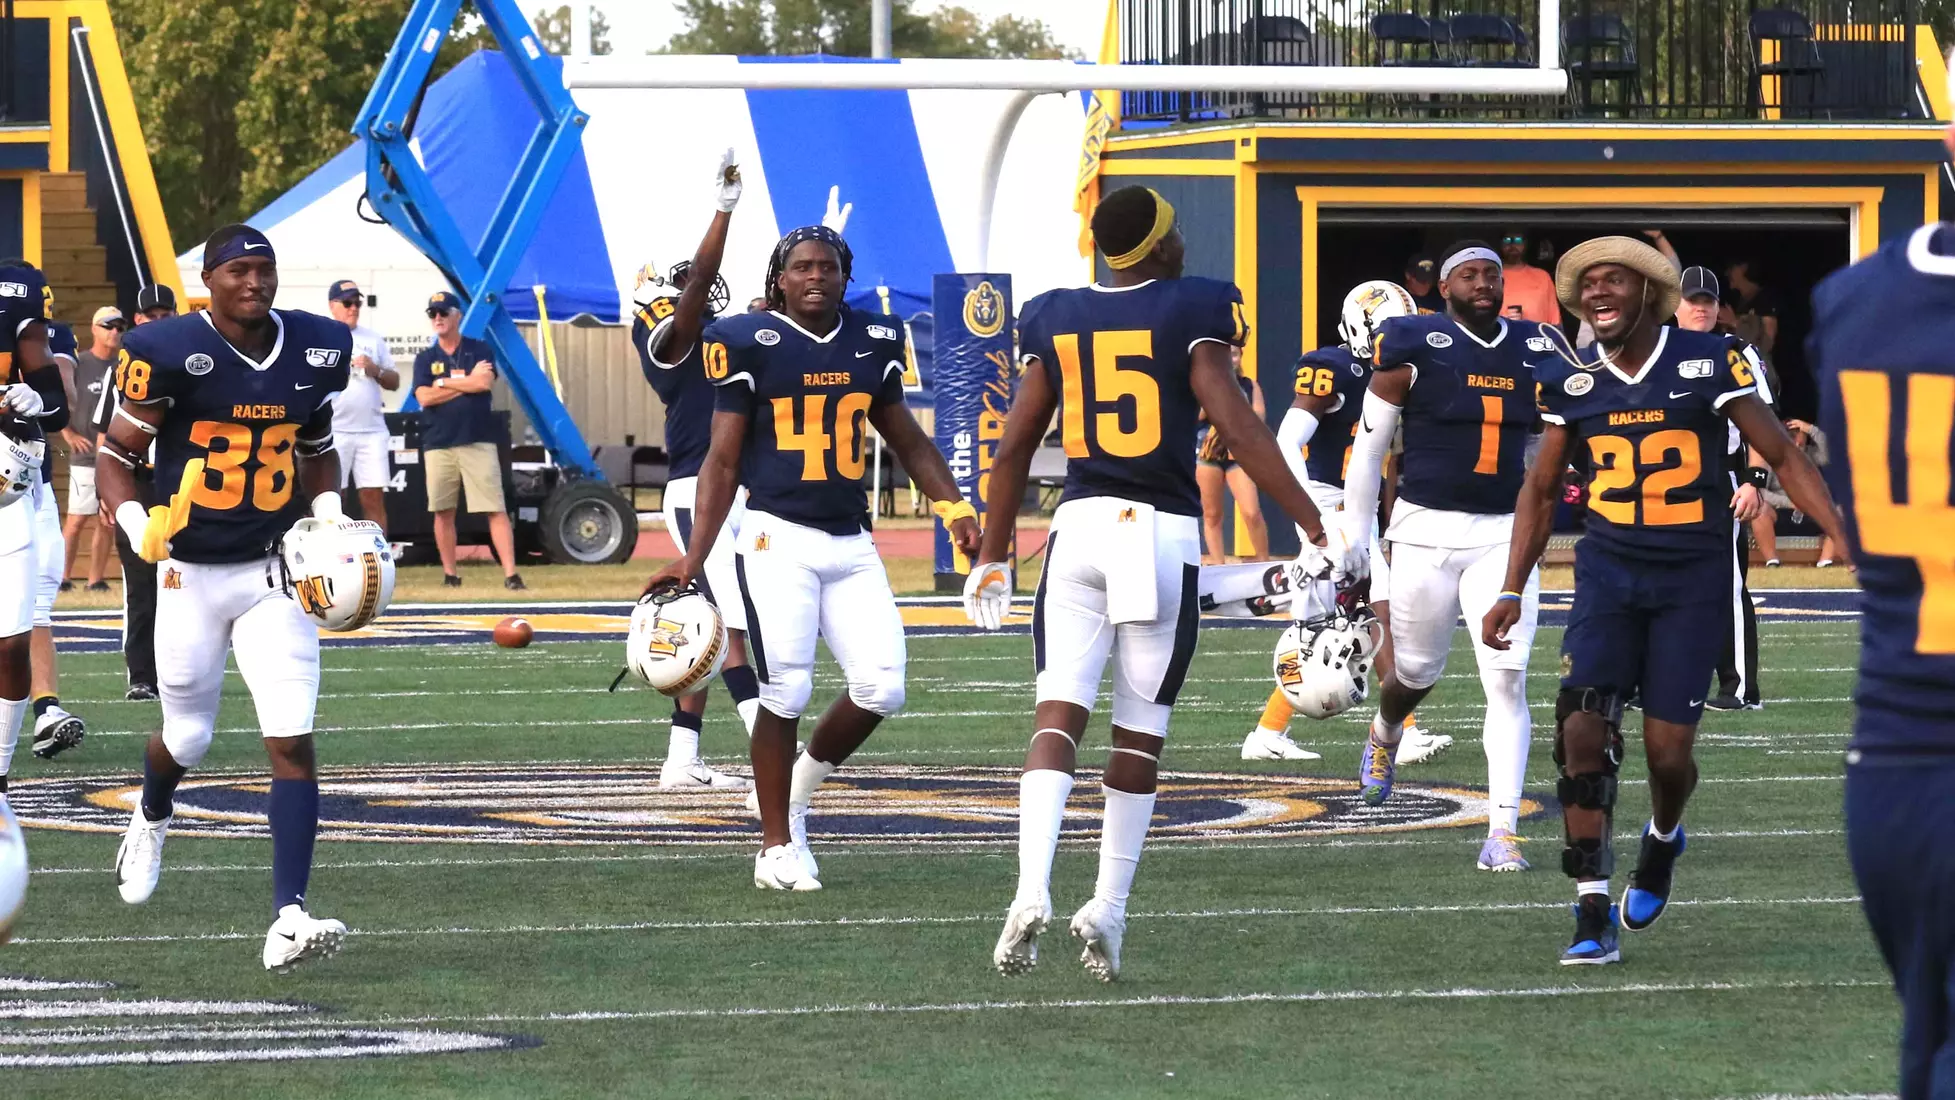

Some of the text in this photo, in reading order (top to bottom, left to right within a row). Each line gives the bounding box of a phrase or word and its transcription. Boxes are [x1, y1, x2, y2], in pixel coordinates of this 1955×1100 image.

[638, 297, 675, 331] 16
[865, 324, 897, 341] 150
[305, 348, 341, 367] 150
[1373, 333, 1385, 365] 1
[116, 348, 152, 401] 38
[802, 371, 851, 387] RACERS
[1294, 366, 1334, 397] 26
[1467, 374, 1515, 391] RACERS
[1676, 358, 1715, 379] 150
[1052, 329, 1162, 459] 15
[232, 403, 287, 419] RACERS
[1608, 409, 1665, 426] RACERS
[769, 391, 874, 481] 40
[1472, 395, 1504, 475] 1
[9, 444, 32, 463] FLOYD
[188, 419, 303, 513] 38
[950, 431, 972, 482] the
[1586, 428, 1704, 526] 22
[1837, 370, 1955, 654] 4
